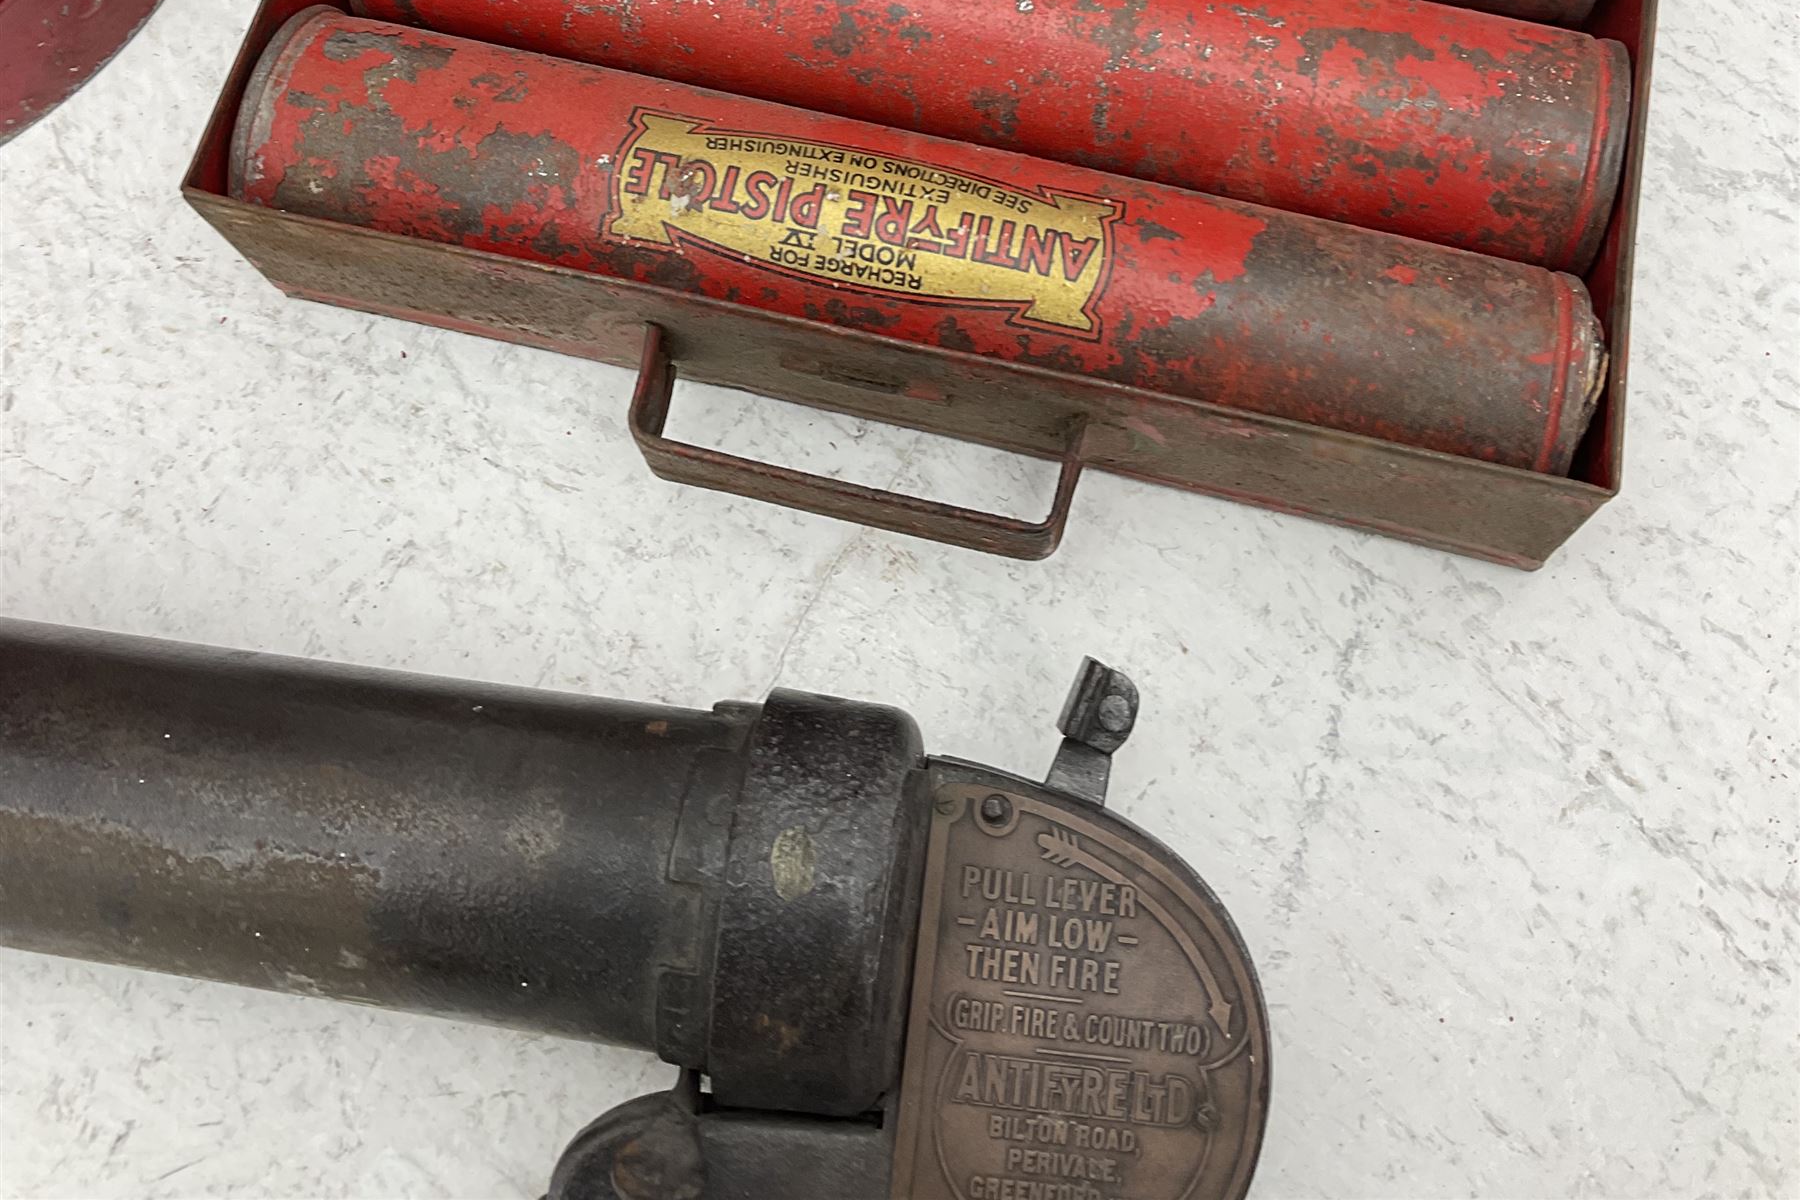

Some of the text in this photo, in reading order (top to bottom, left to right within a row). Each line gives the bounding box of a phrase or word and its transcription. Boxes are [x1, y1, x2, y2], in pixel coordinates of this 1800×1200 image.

[706, 137, 1032, 214] SEE DIRECTIONS ON EXTINGUISHER
[785, 160, 950, 204] EXTINGUISHER
[625, 147, 1099, 282] ANTIFYRE PISTOLE
[770, 245, 922, 290] RECHARGE FOR
[778, 228, 916, 270] MODEL IV
[962, 865, 1137, 918] PULL LEVER
[966, 944, 1121, 994] THEN FIRE
[1010, 1005, 1058, 1039] FIRE
[1063, 1012, 1080, 1042] &
[1084, 1014, 1156, 1050] COUNT
[953, 1052, 1130, 1122] ANTIFYRE
[989, 1114, 1068, 1146] BILTON
